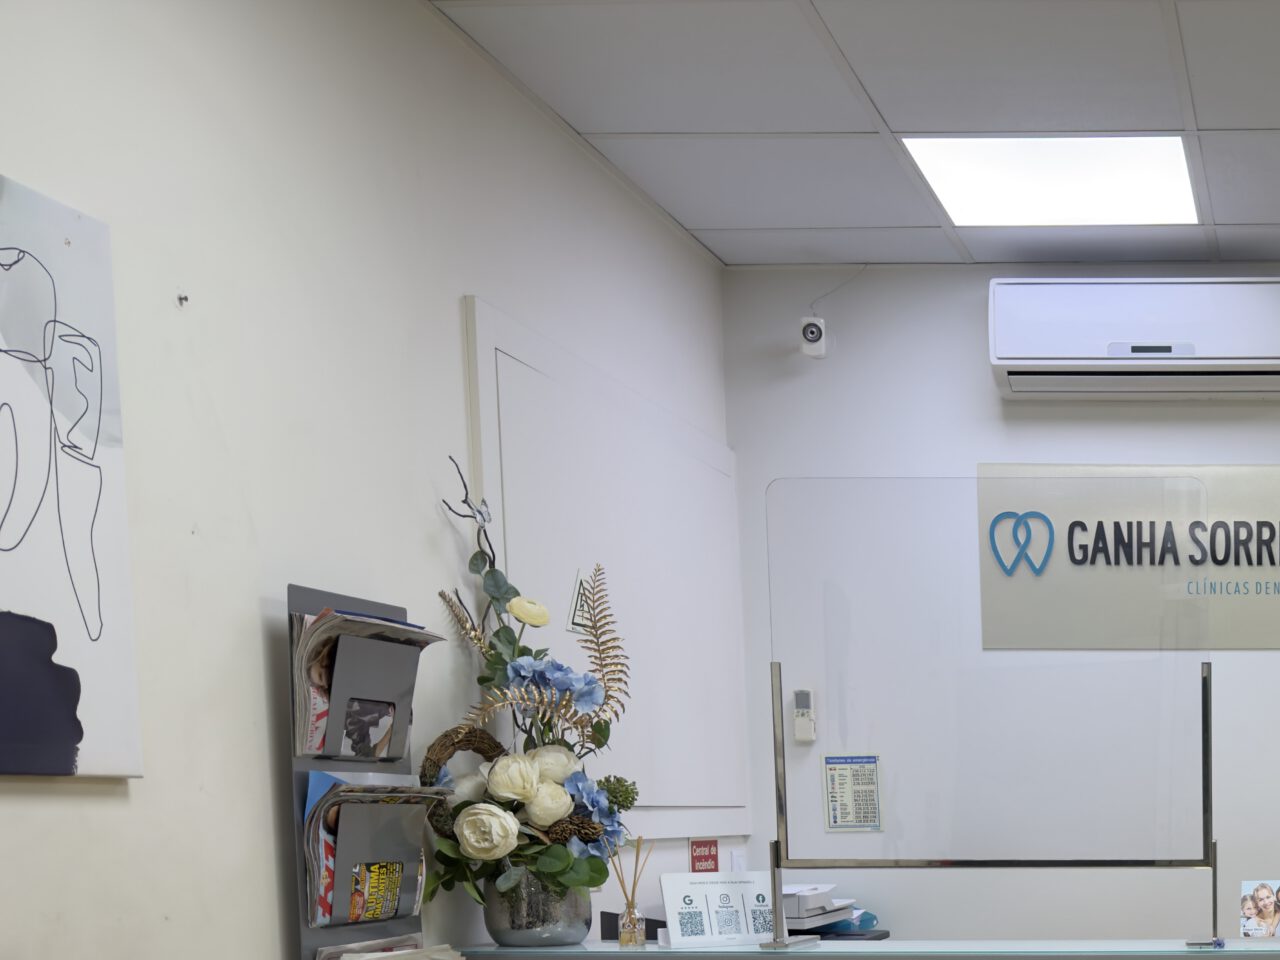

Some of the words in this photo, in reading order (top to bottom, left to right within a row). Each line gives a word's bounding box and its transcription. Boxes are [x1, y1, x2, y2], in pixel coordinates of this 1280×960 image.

[1067, 520, 1181, 567] GANHA
[1187, 577, 1250, 595] CLÍNICAS
[692, 844, 710, 856] Central
[710, 844, 717, 855] de
[378, 867, 387, 897] ANTES
